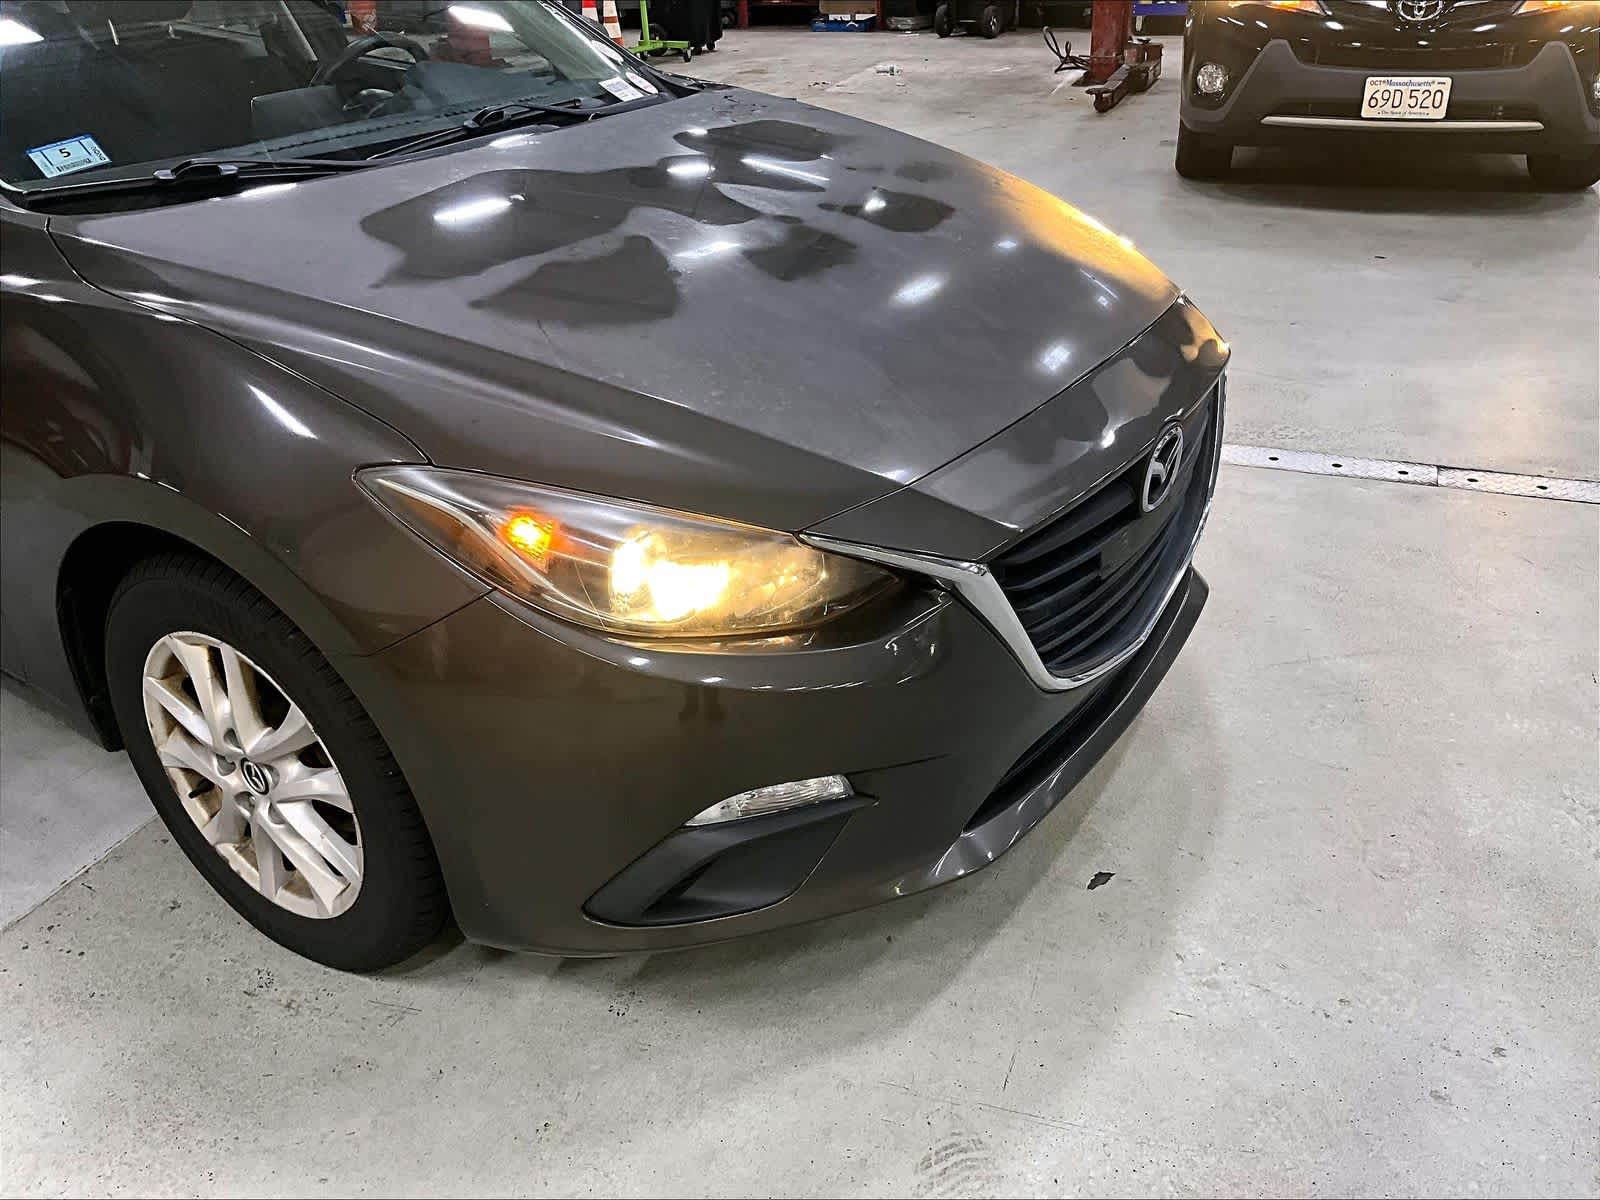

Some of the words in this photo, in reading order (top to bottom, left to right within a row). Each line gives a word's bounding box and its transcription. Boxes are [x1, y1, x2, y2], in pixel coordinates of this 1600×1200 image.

[1387, 79, 1432, 87] Massachusetts
[1368, 89, 1403, 108] 69D
[1408, 89, 1444, 109] 520
[59, 148, 71, 158] 5
